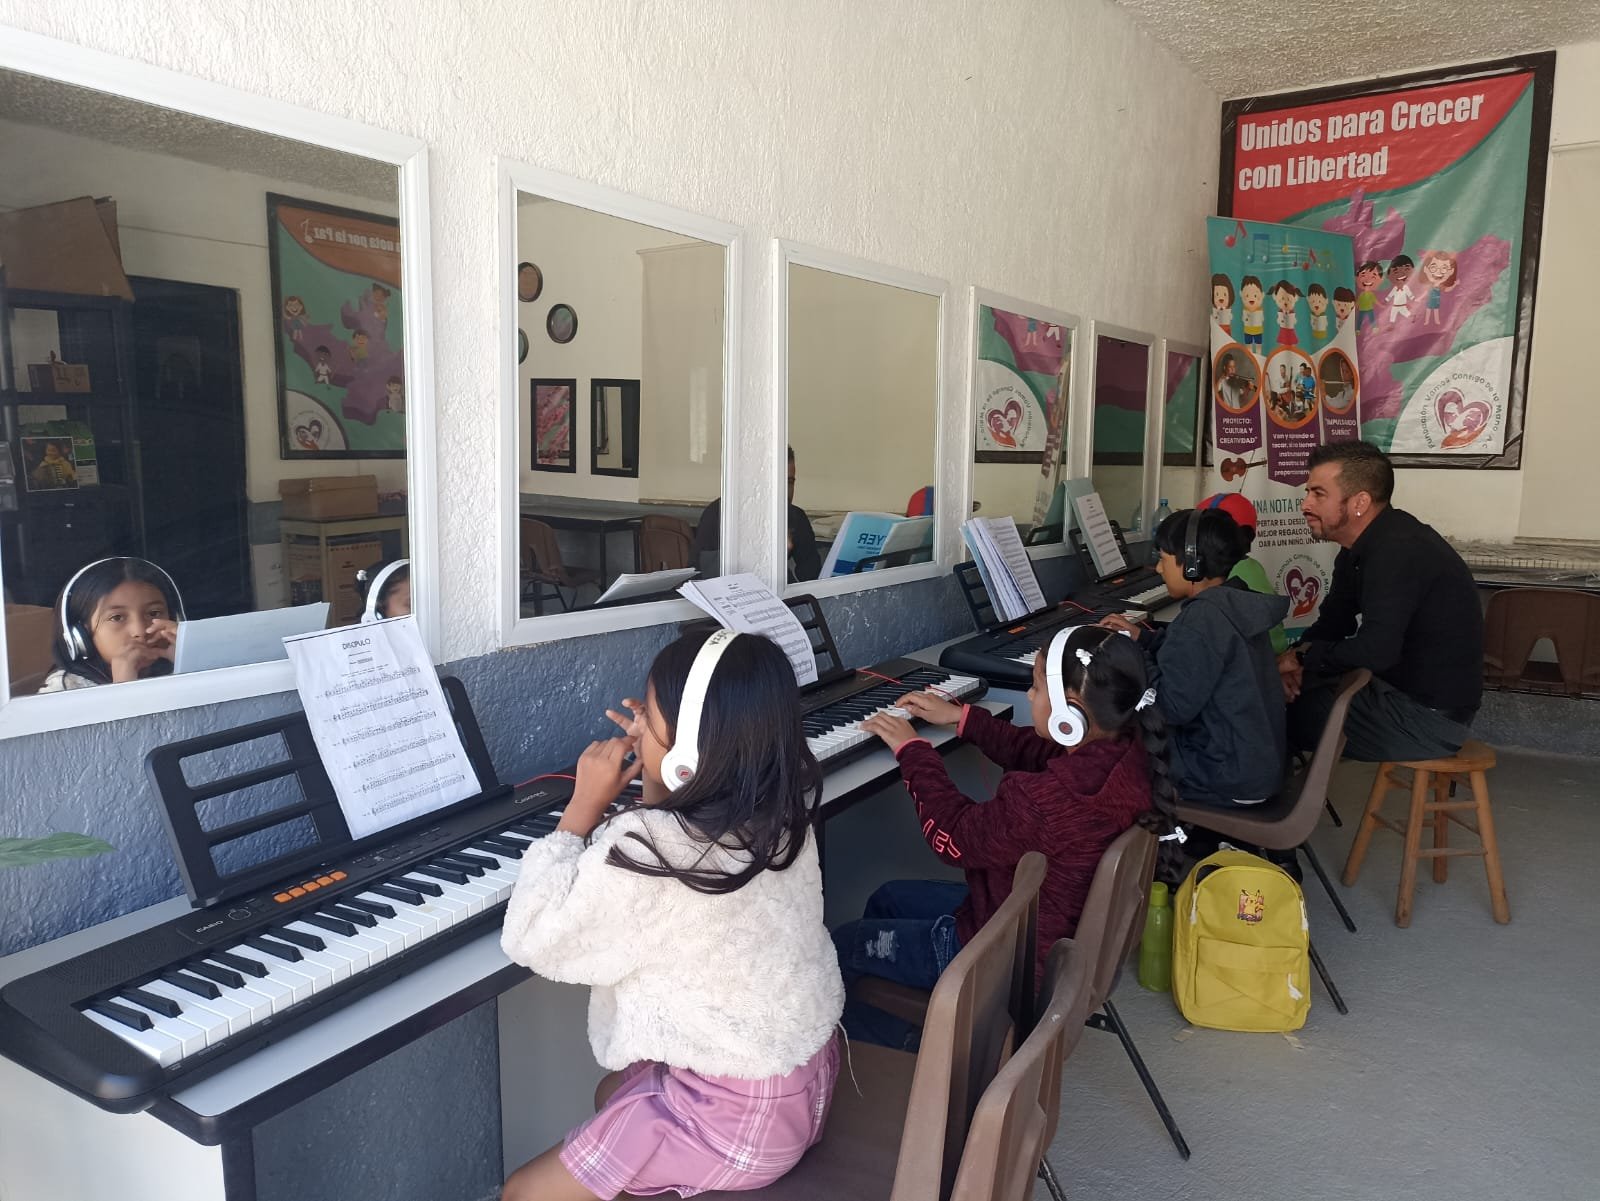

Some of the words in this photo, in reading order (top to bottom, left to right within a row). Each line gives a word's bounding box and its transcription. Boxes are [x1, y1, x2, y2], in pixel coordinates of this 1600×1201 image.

[1241, 118, 1321, 151] Unidos
[1327, 109, 1385, 143] para
[1391, 94, 1485, 131] Crecer
[1239, 163, 1282, 191] con
[1286, 146, 1389, 186] Libertad
[1452, 372, 1485, 384] Contigo
[1492, 404, 1502, 432] Mano
[1270, 499, 1294, 513] NOTA
